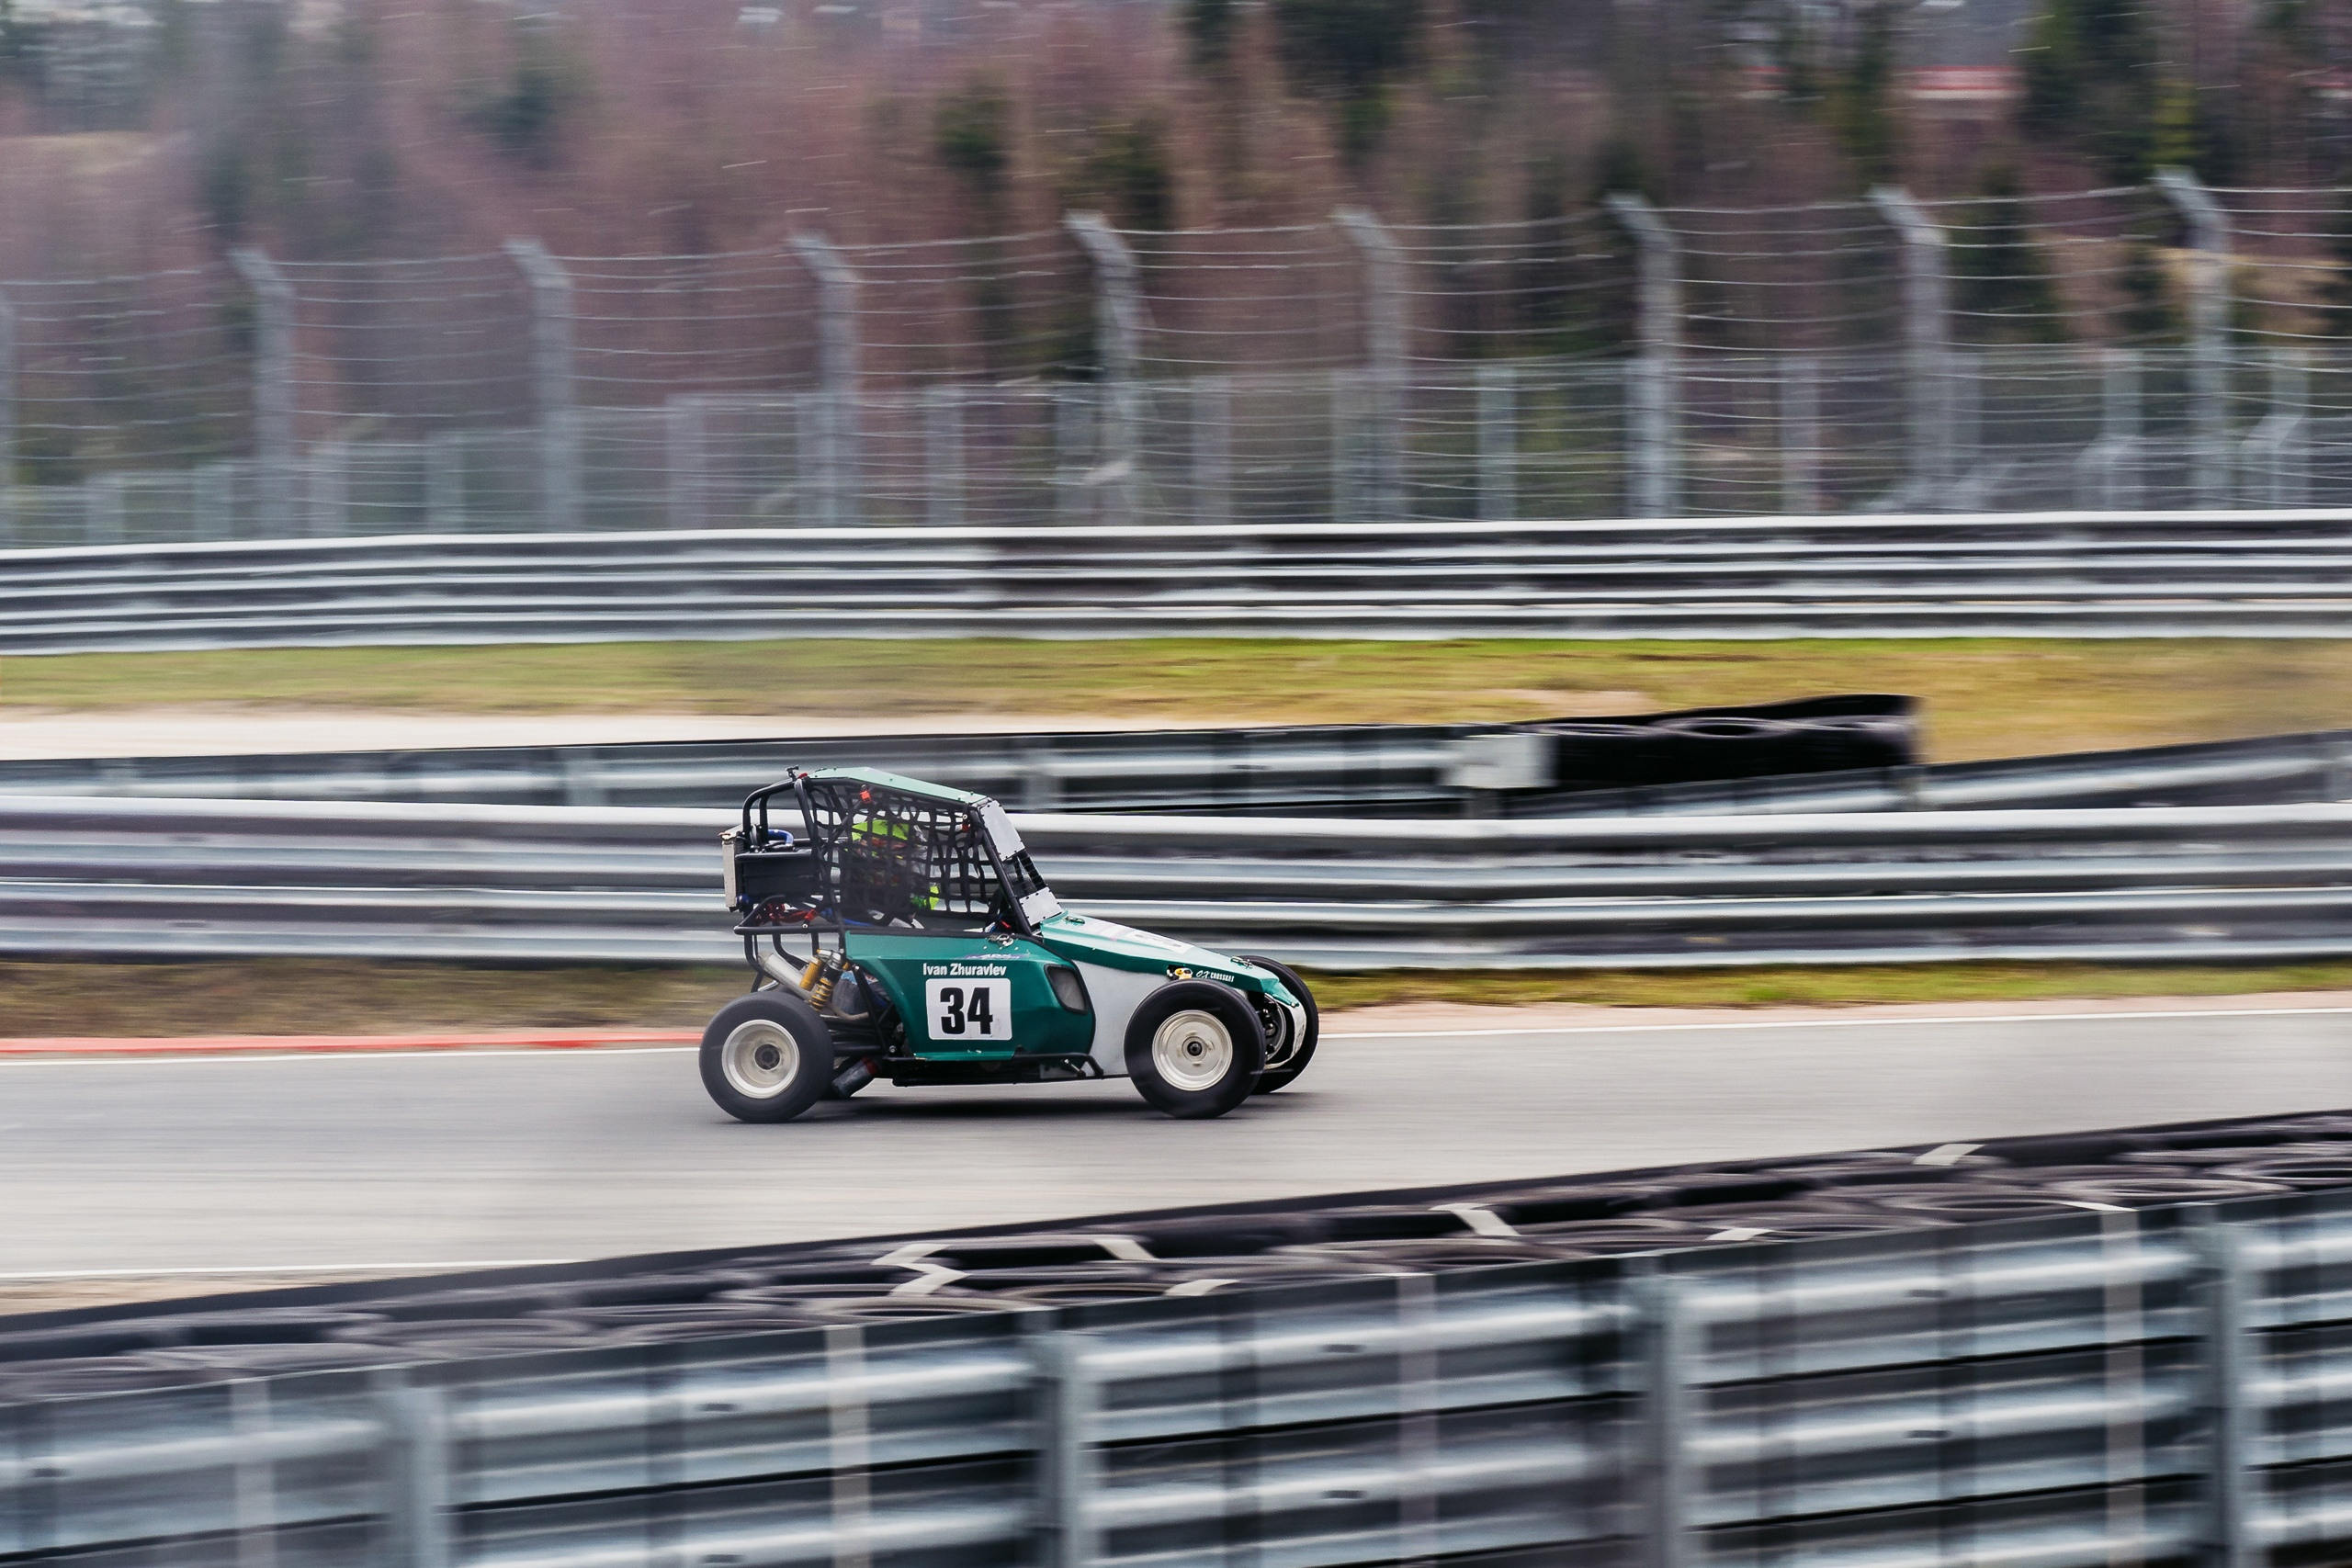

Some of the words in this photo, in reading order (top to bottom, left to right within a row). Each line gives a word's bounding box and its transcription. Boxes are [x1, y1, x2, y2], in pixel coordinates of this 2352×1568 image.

[922, 963, 947, 976] Ivan
[950, 963, 1007, 976] Zhuravlev
[940, 987, 993, 1035] 34
